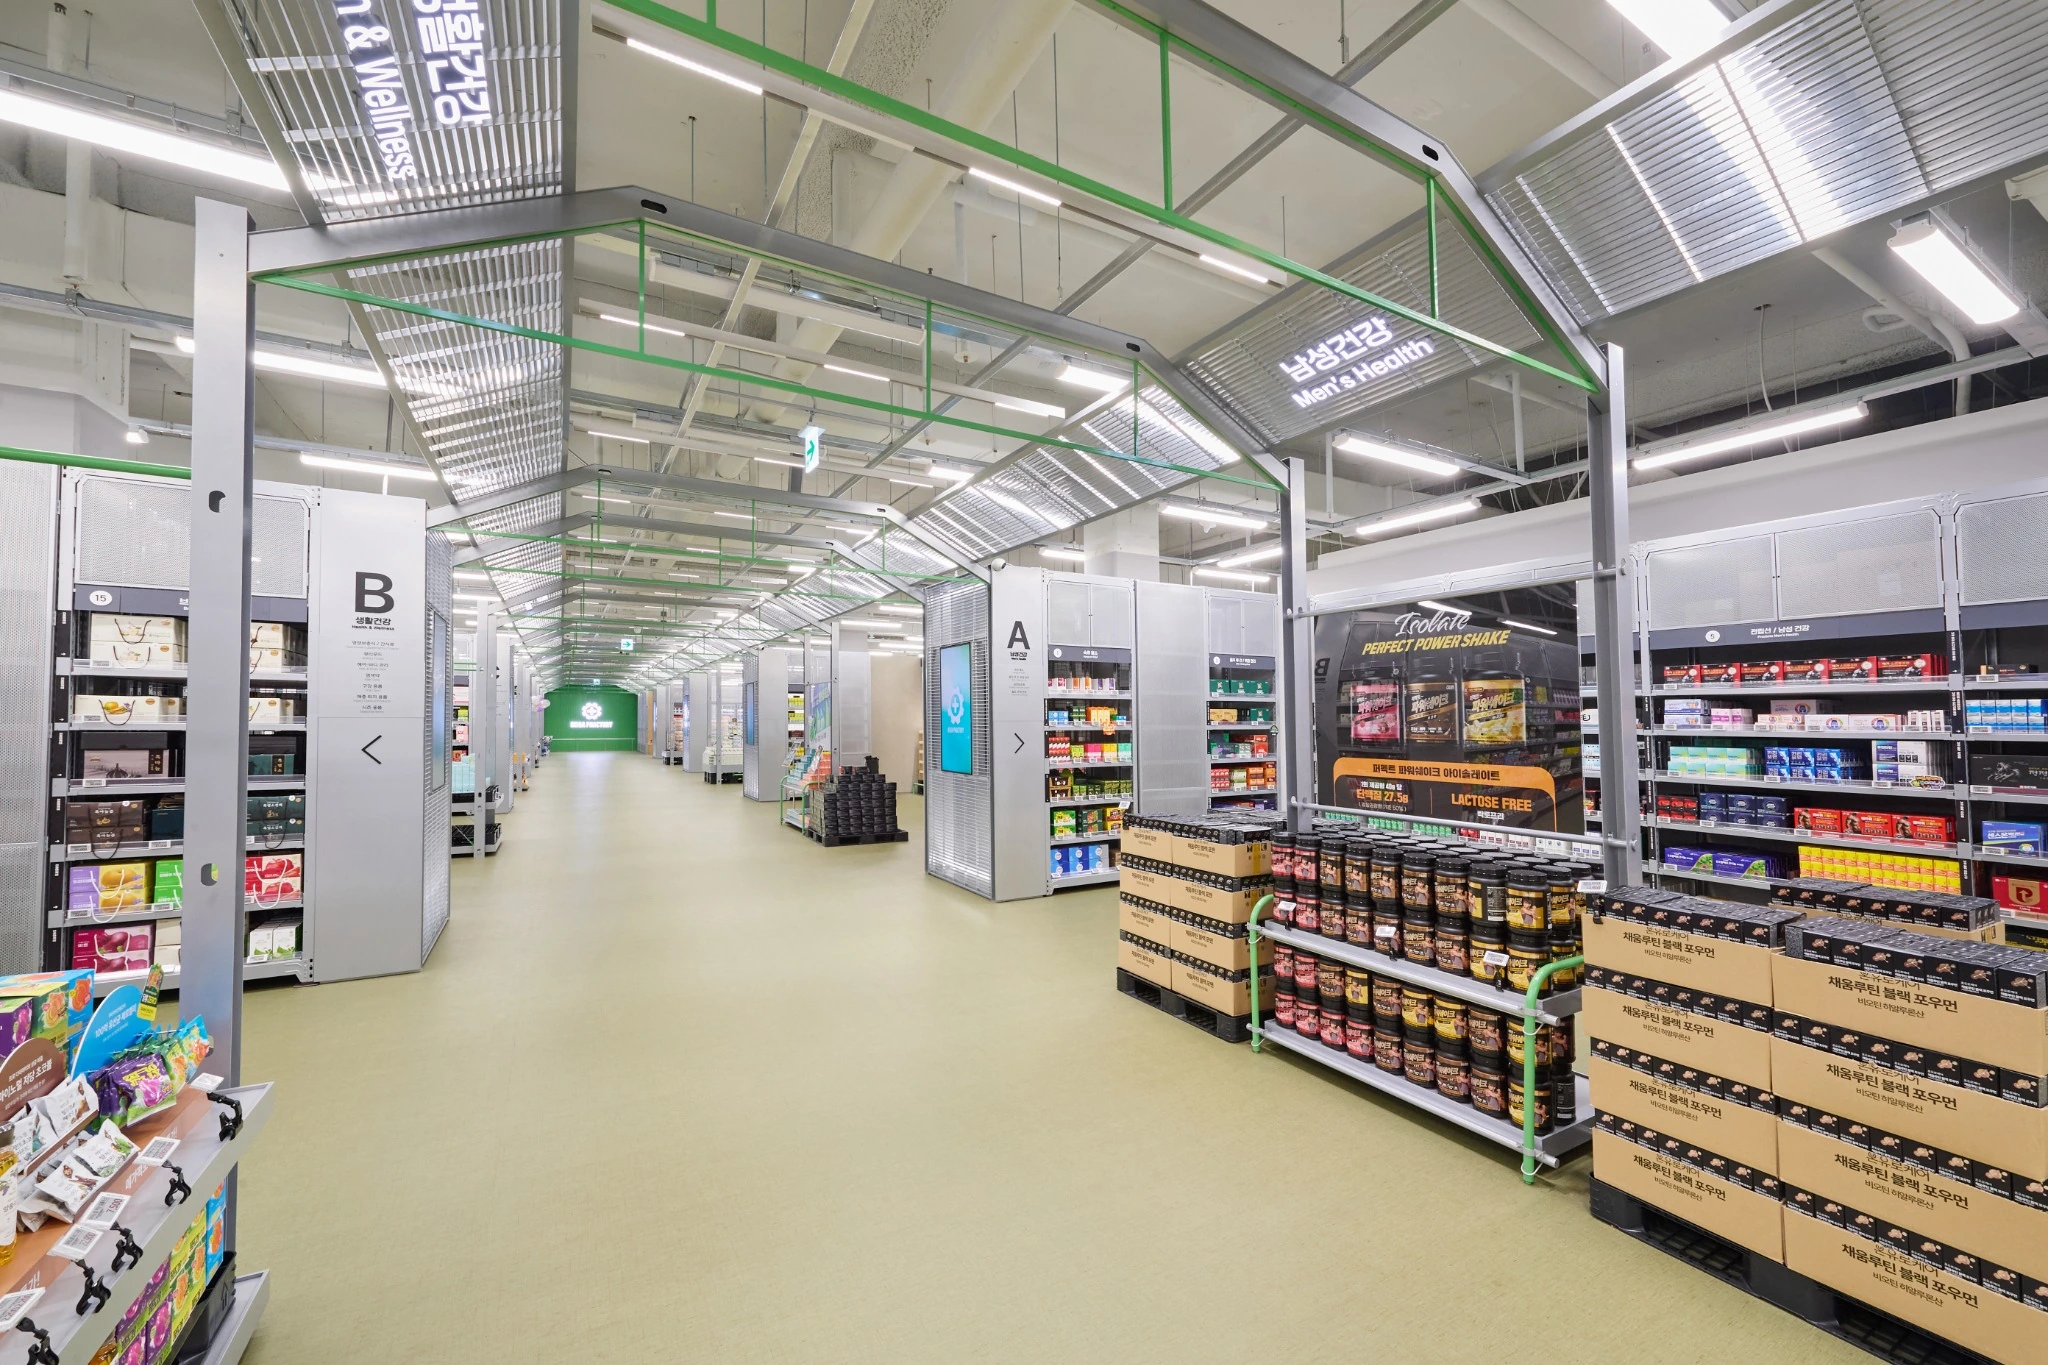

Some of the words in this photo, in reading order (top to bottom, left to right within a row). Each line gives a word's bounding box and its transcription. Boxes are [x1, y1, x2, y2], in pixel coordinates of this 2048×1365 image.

[344, 25, 390, 50] &
[355, 56, 418, 182] Wellness
[1279, 317, 1393, 383] 남성건강
[1291, 375, 1357, 408] Men's
[1352, 339, 1434, 383] Health
[95, 594, 107, 602] 15
[355, 571, 395, 614] B
[355, 616, 392, 626] 생활건강
[1007, 620, 1031, 650] A
[1394, 610, 1472, 637] Isolate
[1362, 639, 1414, 656] PERFECT
[1413, 634, 1464, 651] POWER
[1461, 630, 1512, 648] SHAKE
[1373, 763, 1396, 774] 퍼펙트
[1398, 765, 1440, 777] 파워쉐이크
[1443, 767, 1500, 781] 아이솔레이트
[1356, 789, 1382, 800] 단백질
[1384, 792, 1409, 804] 27.5g
[1451, 793, 1499, 809] LACTOSE
[1501, 797, 1532, 812] FREE
[1622, 931, 1661, 947] 채움루틴
[1662, 939, 1682, 952] 블랙
[1684, 944, 1715, 959] 포우먼
[1644, 949, 1662, 959] 비오틴
[1662, 952, 1692, 964] 히알루론산
[1828, 975, 1880, 997] 채움루틴
[1882, 985, 1911, 1004] 블랙
[1913, 993, 1959, 1014] 포우먼
[1857, 997, 1882, 1010] 비오틴
[1883, 1001, 1925, 1019] 히알루론산
[1622, 1004, 1660, 1022] 채움루틴
[1661, 1015, 1681, 1030] 블랙
[1683, 1022, 1714, 1038] 포우먼
[1643, 1023, 1661, 1034] 비오틴
[1661, 1028, 1691, 1042] 히알루론산
[1629, 1080, 1667, 1100] 채움루틴
[1668, 1093, 1689, 1108] 블랙
[1690, 1100, 1722, 1119] 포우먼
[1826, 1063, 1879, 1088] 채움루틴
[1881, 1076, 1910, 1096] 블랙
[1912, 1087, 1958, 1110] 포우먼
[1855, 1087, 1881, 1102] 비오틴
[1881, 1092, 1924, 1114] 히알루론산
[1650, 1100, 1668, 1112] 비오틴
[1668, 1105, 1698, 1122] 히알루론산
[1633, 1154, 1671, 1178] 채움루틴
[1672, 1170, 1693, 1188] 블랙
[1694, 1180, 1726, 1201] 포우먼
[1654, 1176, 1672, 1190] 비오틴
[1672, 1184, 1703, 1202] 히알루론산
[1834, 1153, 1888, 1182] 채움루틴
[1891, 1171, 1920, 1193] 블랙
[1922, 1183, 1969, 1210] 포우먼
[1864, 1179, 1890, 1195] 비오틴
[1891, 1186, 1935, 1210] 히알루론산
[1841, 1243, 1897, 1275] 채움루틴
[1898, 1265, 1929, 1289] 블랙
[1931, 1280, 1979, 1309] 포우먼
[1872, 1271, 1899, 1289] 비오틴
[1899, 1281, 1944, 1308] 히알루론산
